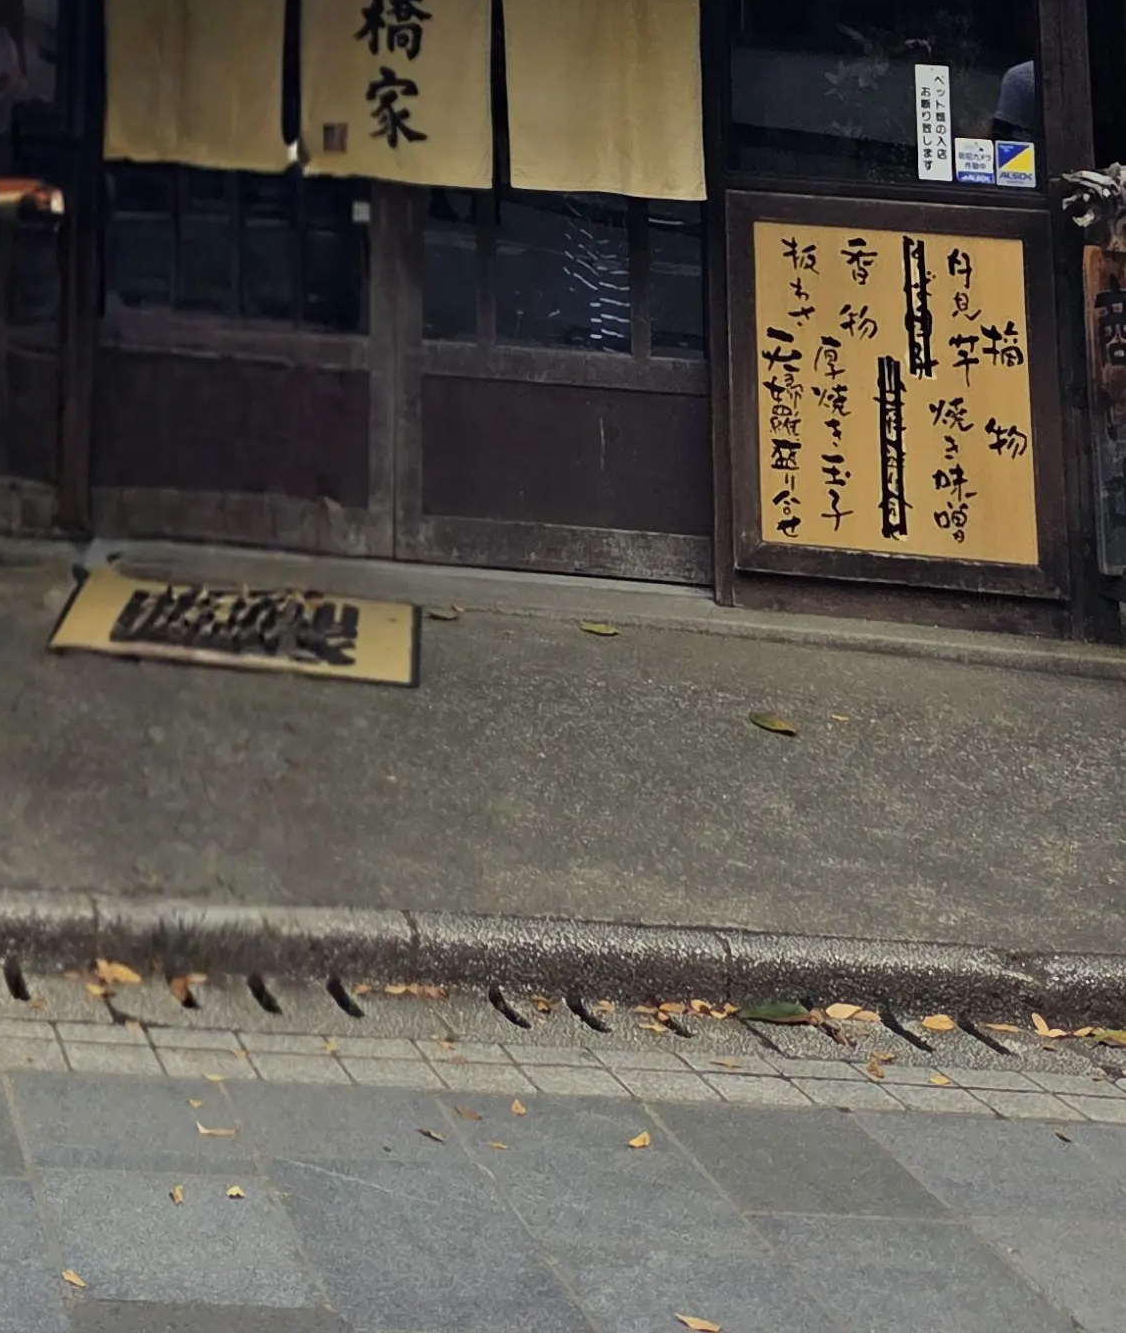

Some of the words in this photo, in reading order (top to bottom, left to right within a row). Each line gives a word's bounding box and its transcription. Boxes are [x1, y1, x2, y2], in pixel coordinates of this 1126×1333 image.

[920, 86, 933, 171] お断り致します
[934, 75, 948, 161] ペット類の入店
[1000, 171, 1034, 182] ALSOK
[781, 237, 820, 328] 板わさ
[838, 237, 879, 342] 香物
[811, 335, 854, 533] 厚焼き玉子
[929, 396, 978, 543] 焼き味噌
